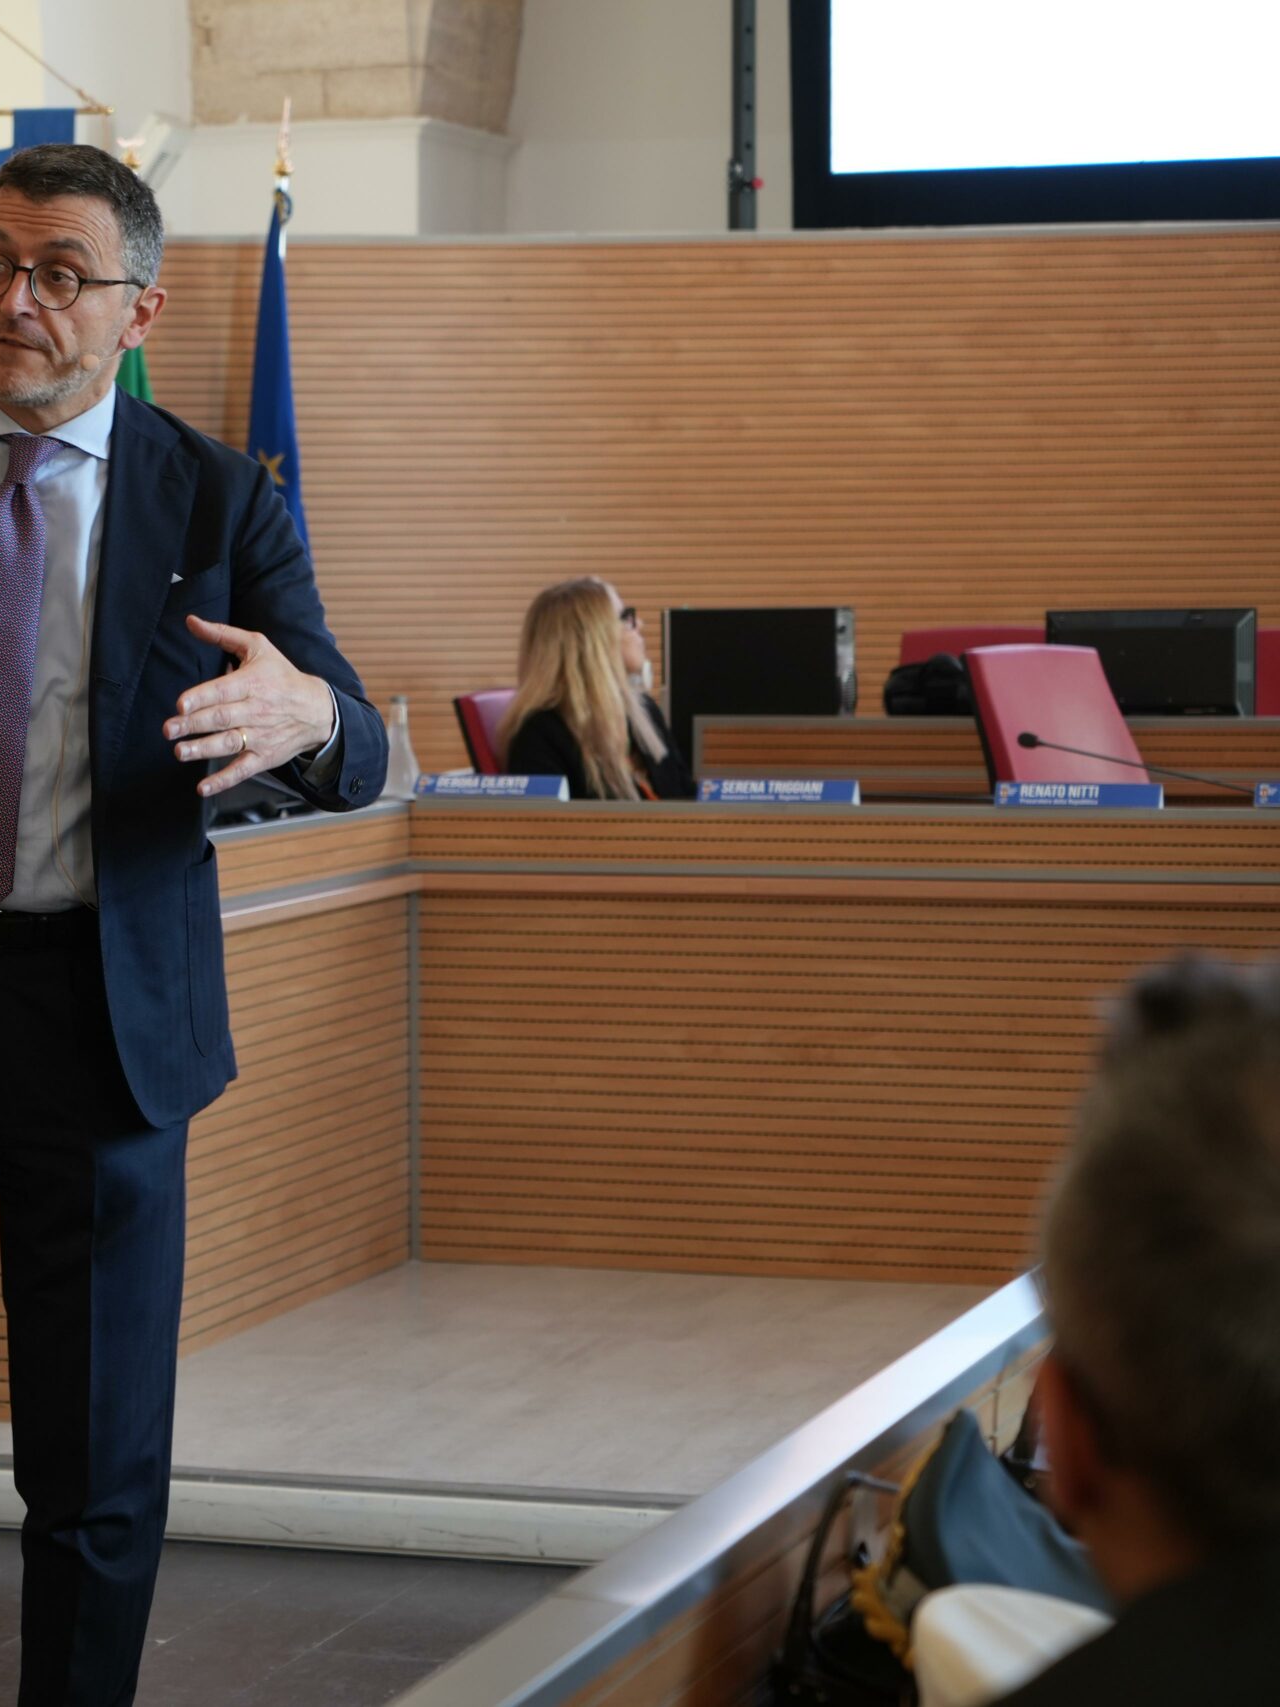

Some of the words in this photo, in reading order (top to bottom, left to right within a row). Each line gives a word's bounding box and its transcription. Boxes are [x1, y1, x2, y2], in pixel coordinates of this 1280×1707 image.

[721, 780, 765, 794] SERENA
[767, 780, 824, 794] TRIGGIANI
[1019, 784, 1065, 798] RENATO
[1067, 784, 1100, 798] NITTI
